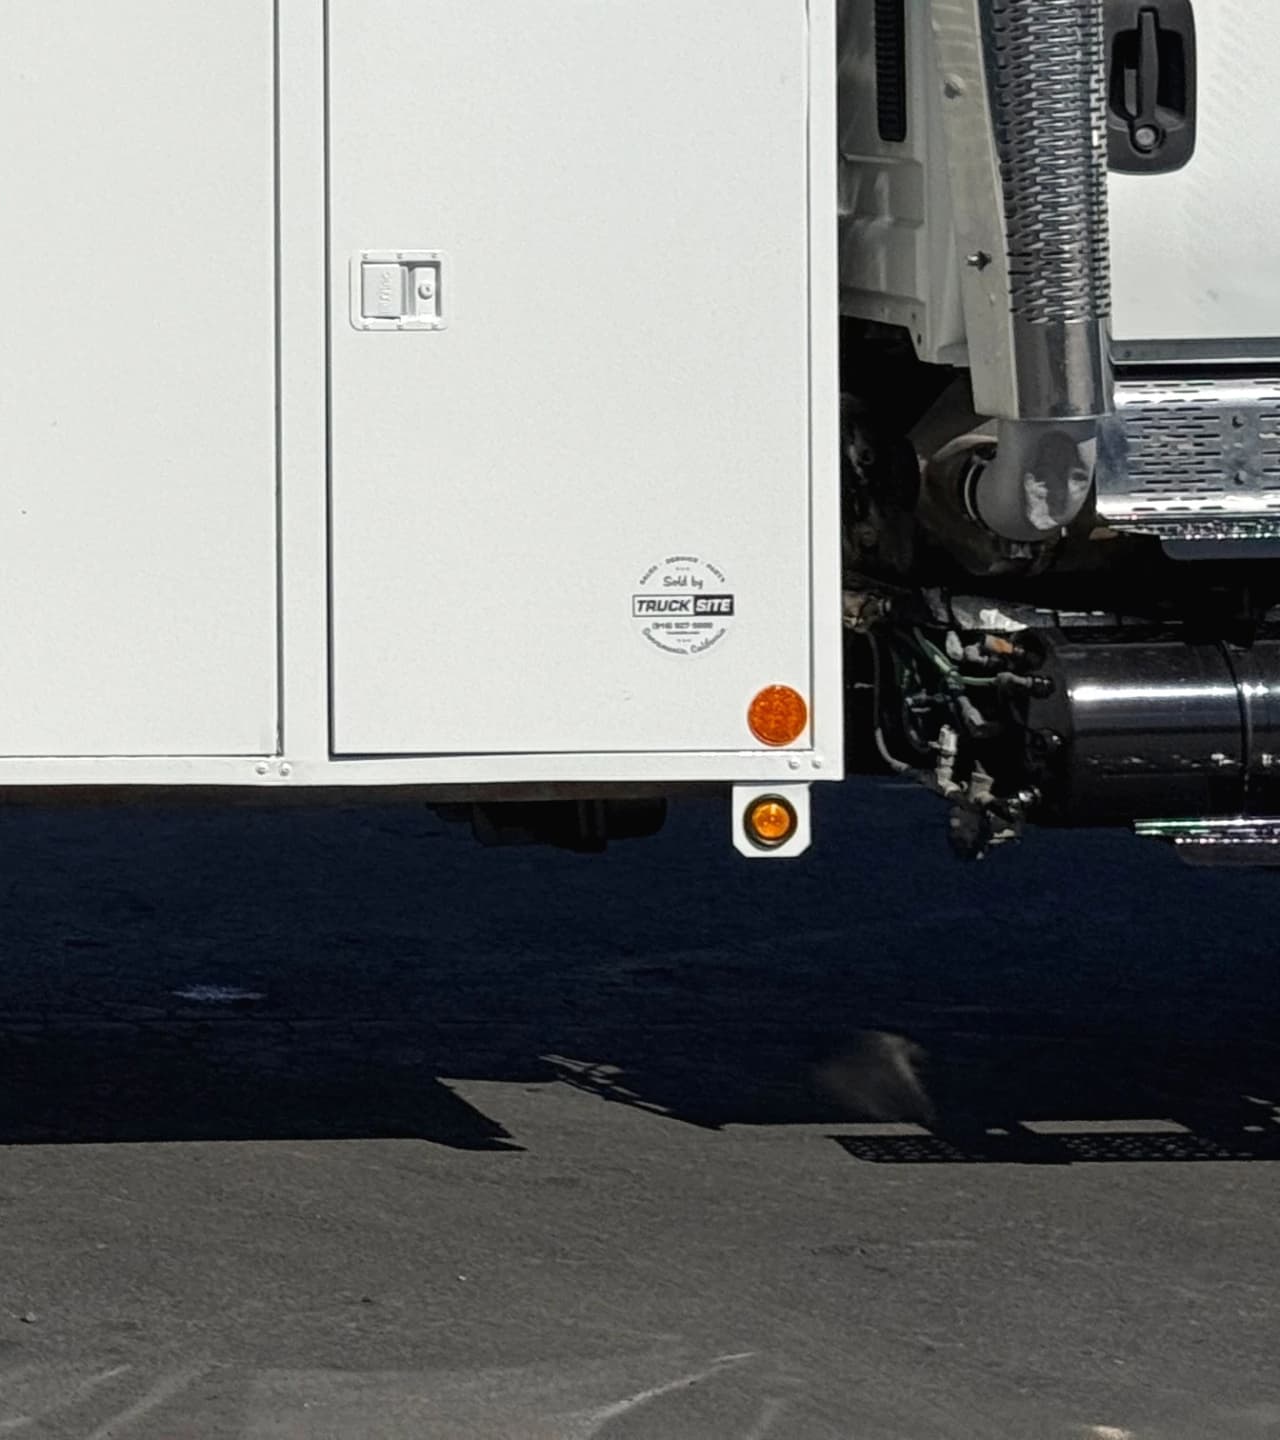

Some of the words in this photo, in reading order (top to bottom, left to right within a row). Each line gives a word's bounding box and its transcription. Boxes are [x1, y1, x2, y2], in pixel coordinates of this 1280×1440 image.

[662, 575, 687, 588] Sold
[691, 575, 704, 590] by
[637, 599, 691, 613] TRUCK
[695, 598, 732, 613] SITE
